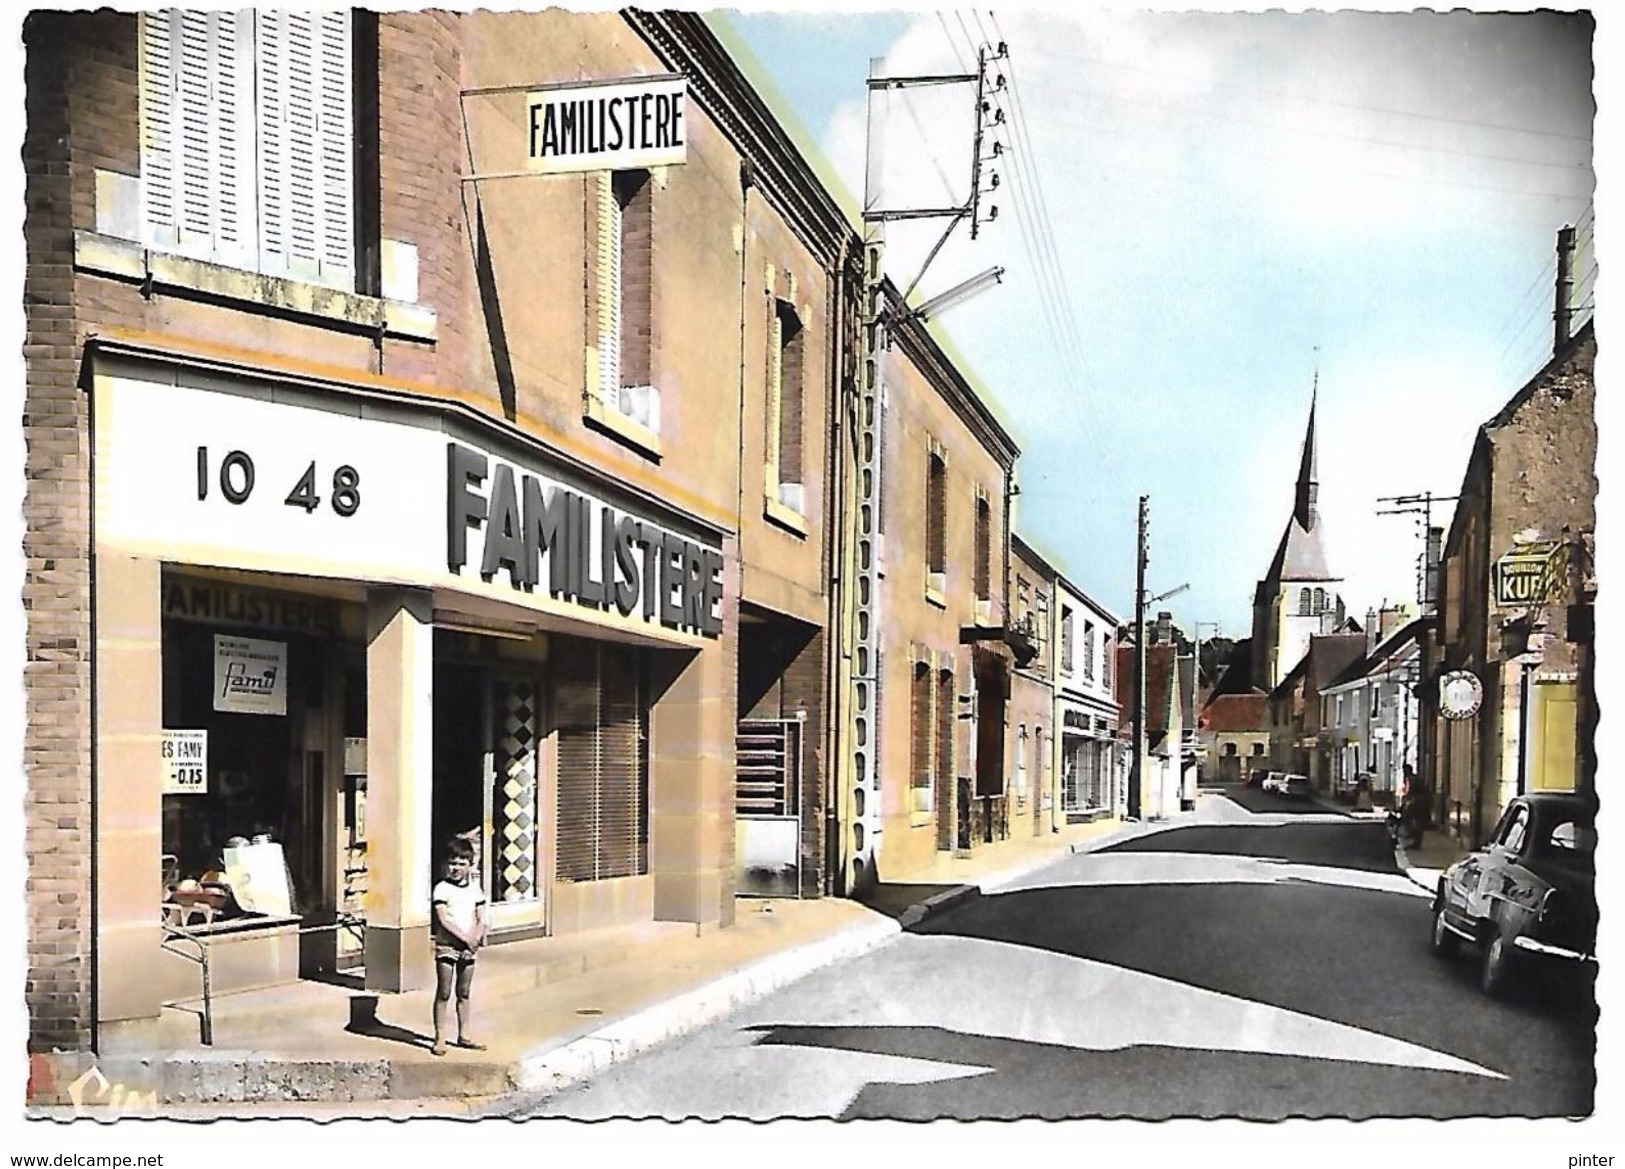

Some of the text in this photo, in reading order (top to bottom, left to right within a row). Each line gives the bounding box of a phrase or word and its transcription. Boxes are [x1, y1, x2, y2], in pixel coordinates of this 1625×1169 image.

[197, 446, 360, 517] 10 48
[447, 442, 723, 641] FAMILISTERE
[1502, 563, 1545, 576] BOUILLON
[162, 583, 331, 631] AMILISTER
[171, 769, 203, 785] -0.15
